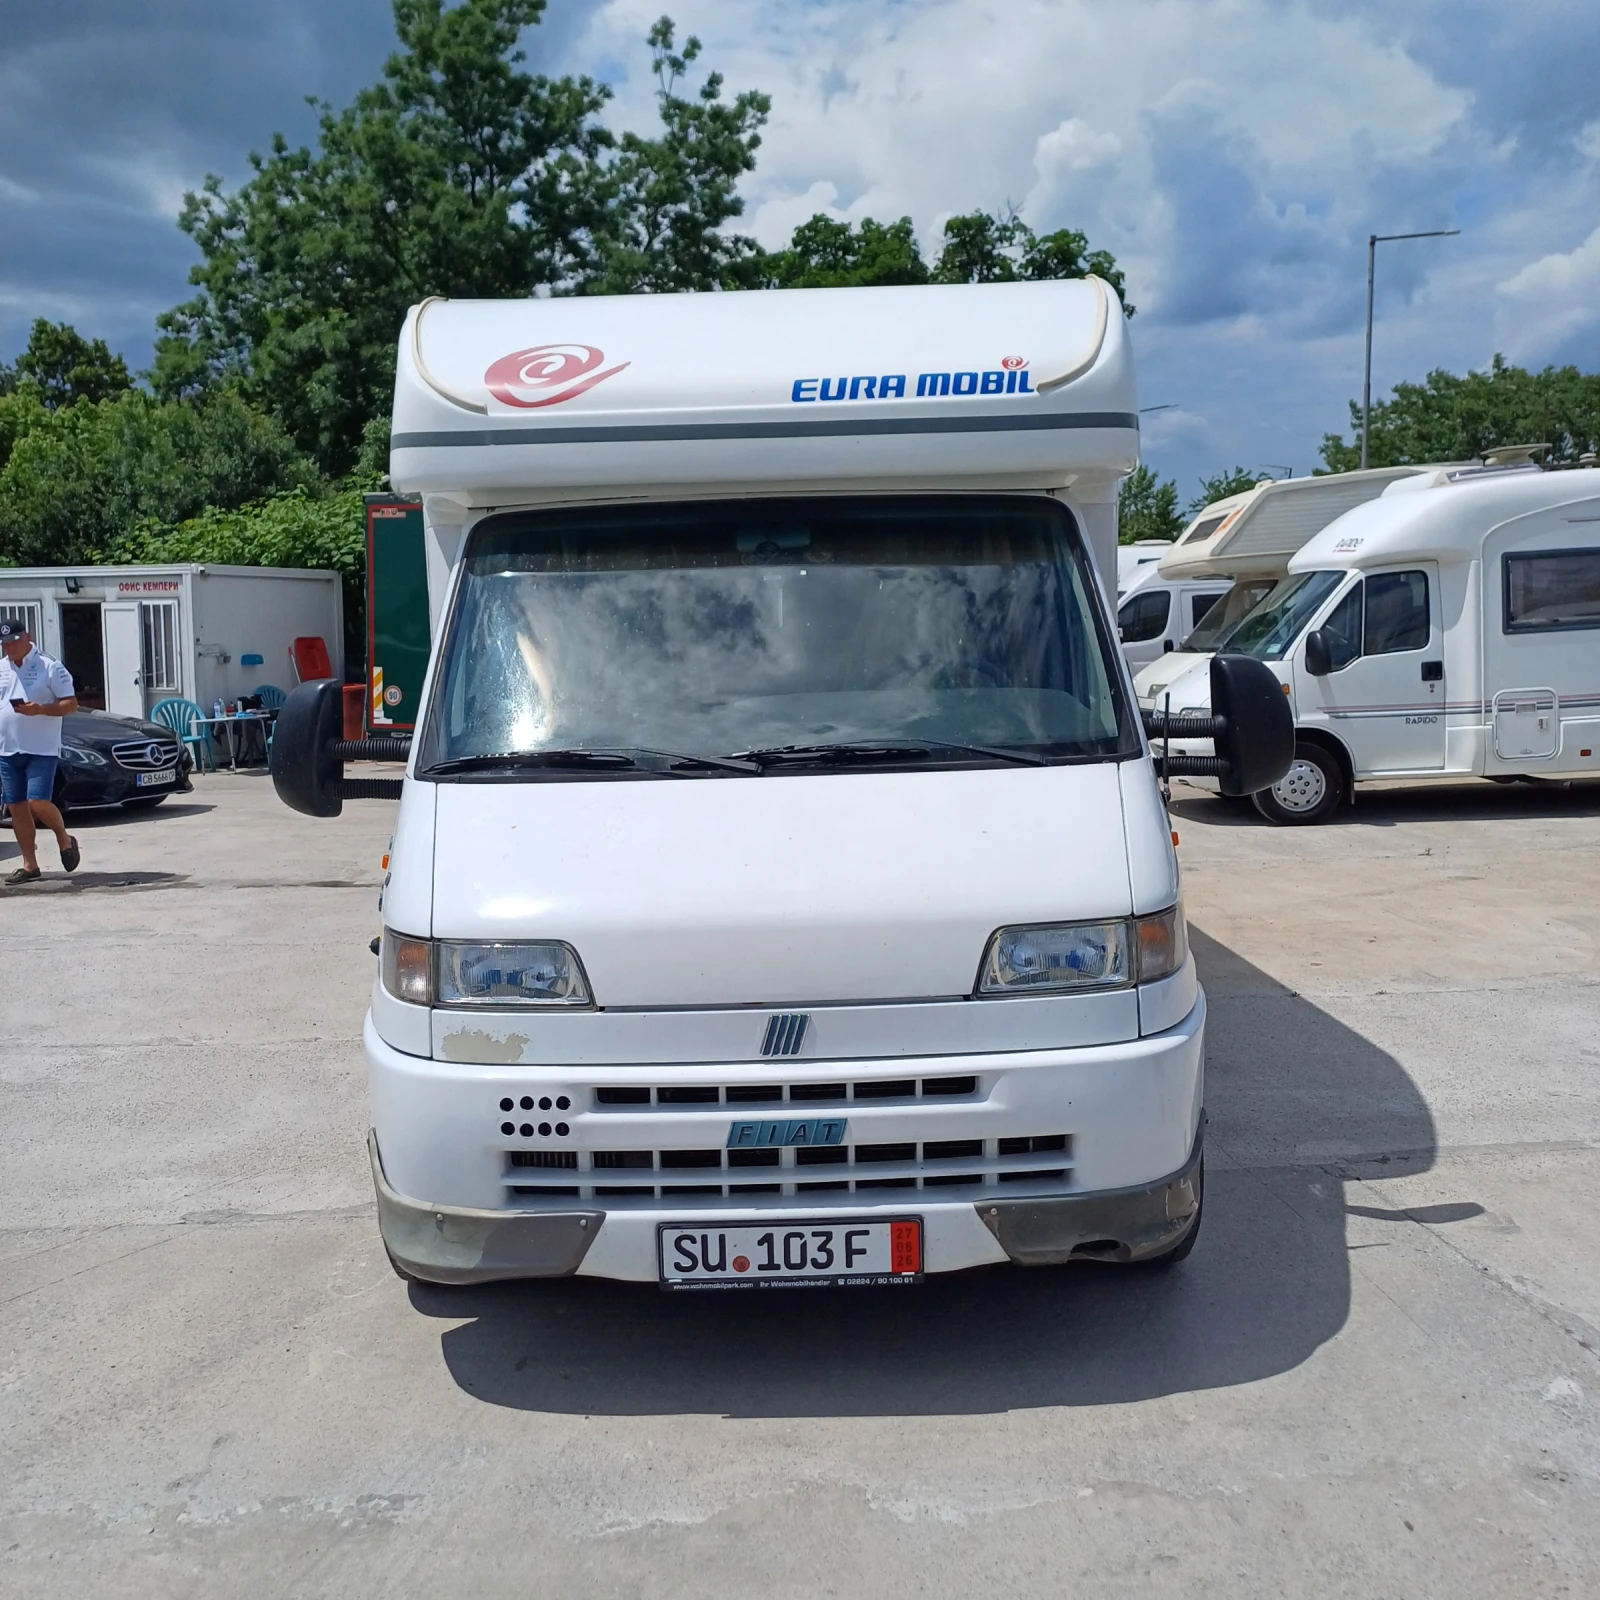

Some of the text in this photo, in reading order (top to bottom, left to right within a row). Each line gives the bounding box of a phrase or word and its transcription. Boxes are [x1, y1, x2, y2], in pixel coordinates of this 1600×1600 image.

[792, 374, 906, 402] EURA
[118, 581, 179, 592] ОФИС КЕМПЕРИ
[389, 691, 398, 699] 90
[1405, 716, 1438, 725] RAPIDO
[737, 1123, 838, 1144] FIAT
[673, 1229, 870, 1272] SU 103 F
